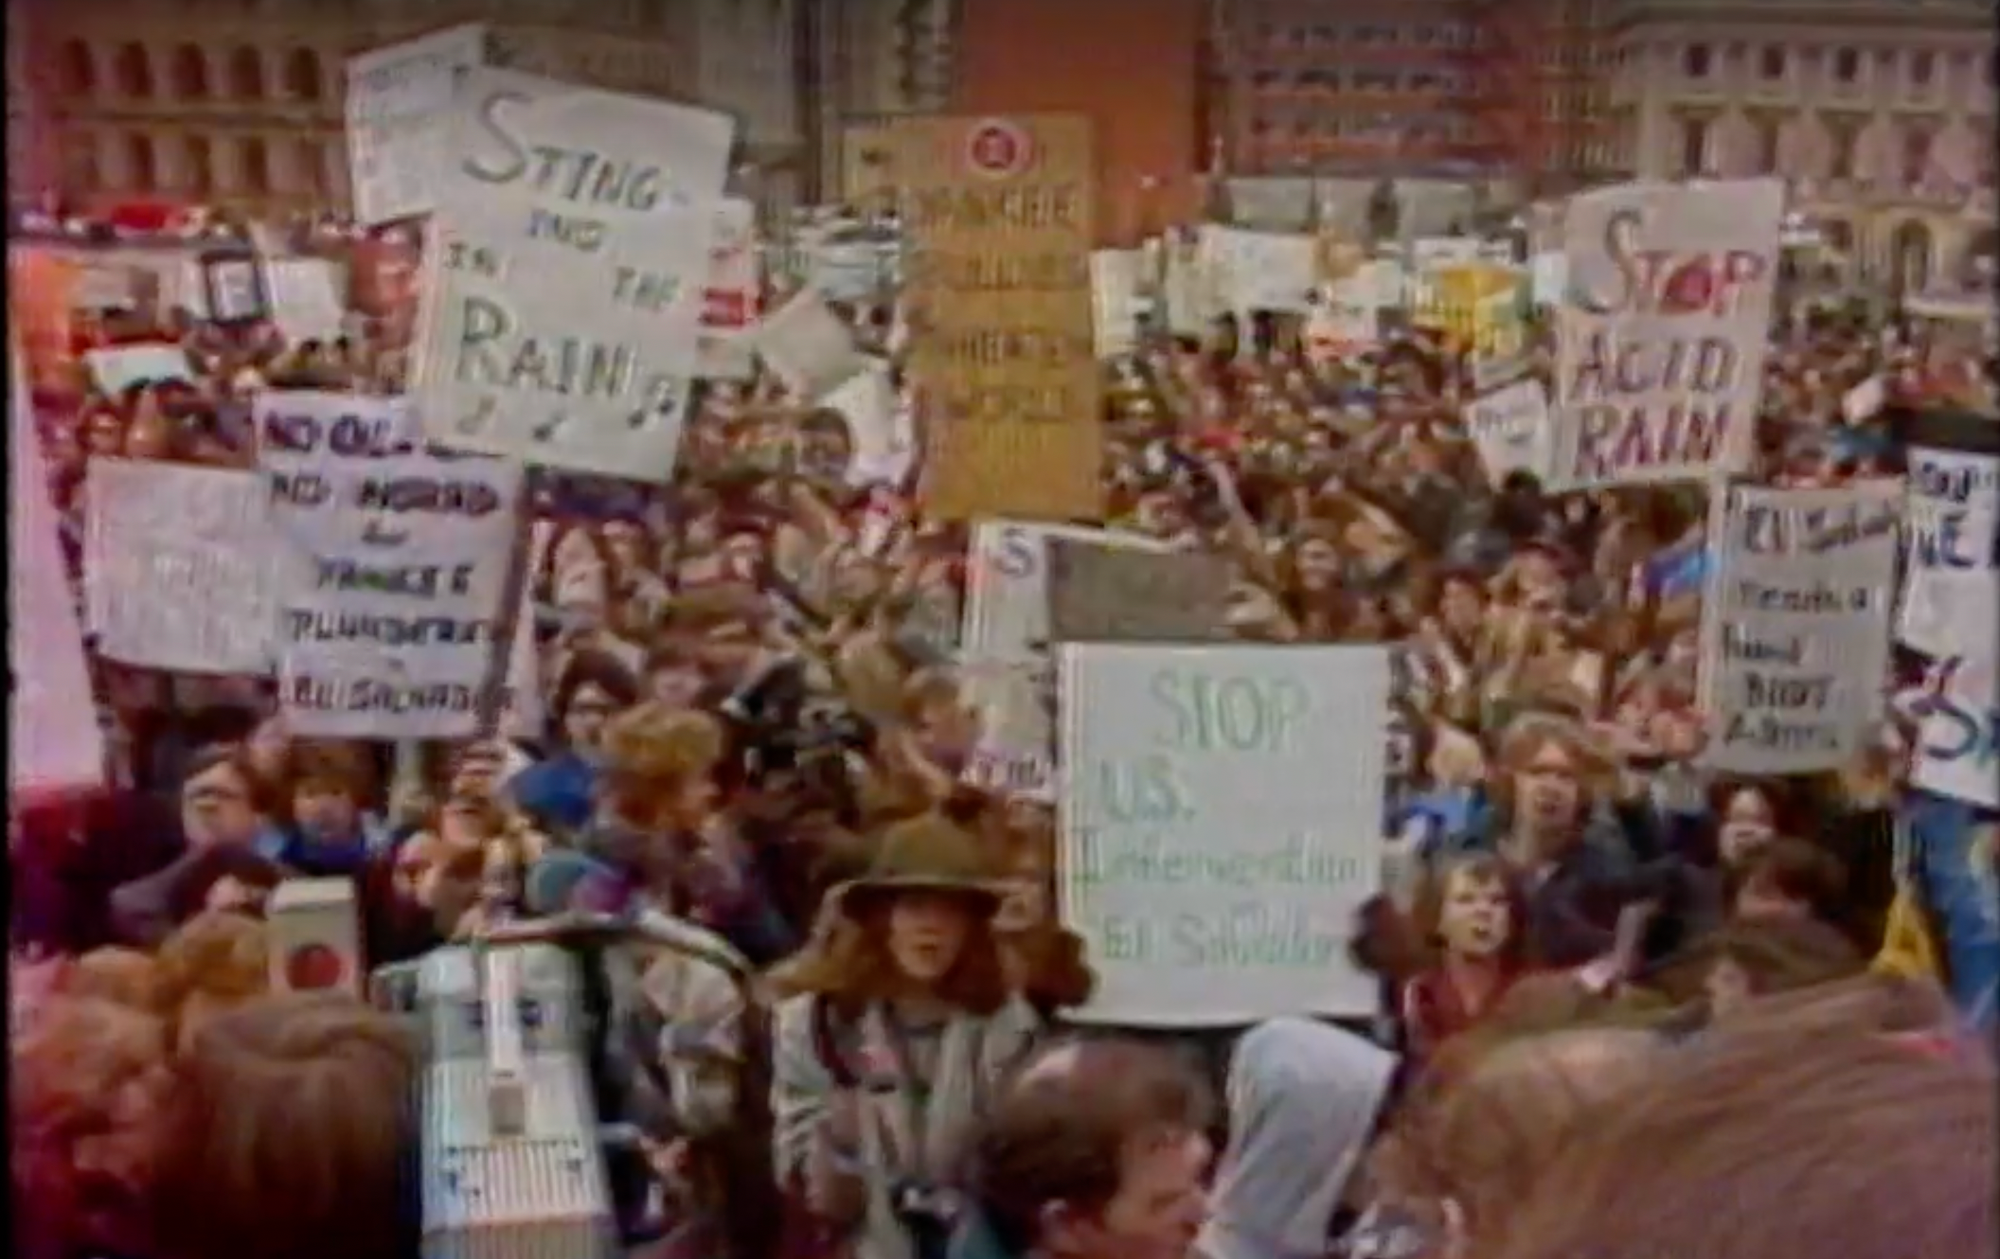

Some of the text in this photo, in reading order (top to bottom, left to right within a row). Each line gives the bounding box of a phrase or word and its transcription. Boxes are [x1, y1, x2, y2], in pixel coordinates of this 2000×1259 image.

[1570, 334, 1740, 398] ACID
[1572, 402, 1732, 480] RAIN
[1148, 664, 1314, 752] STOP
